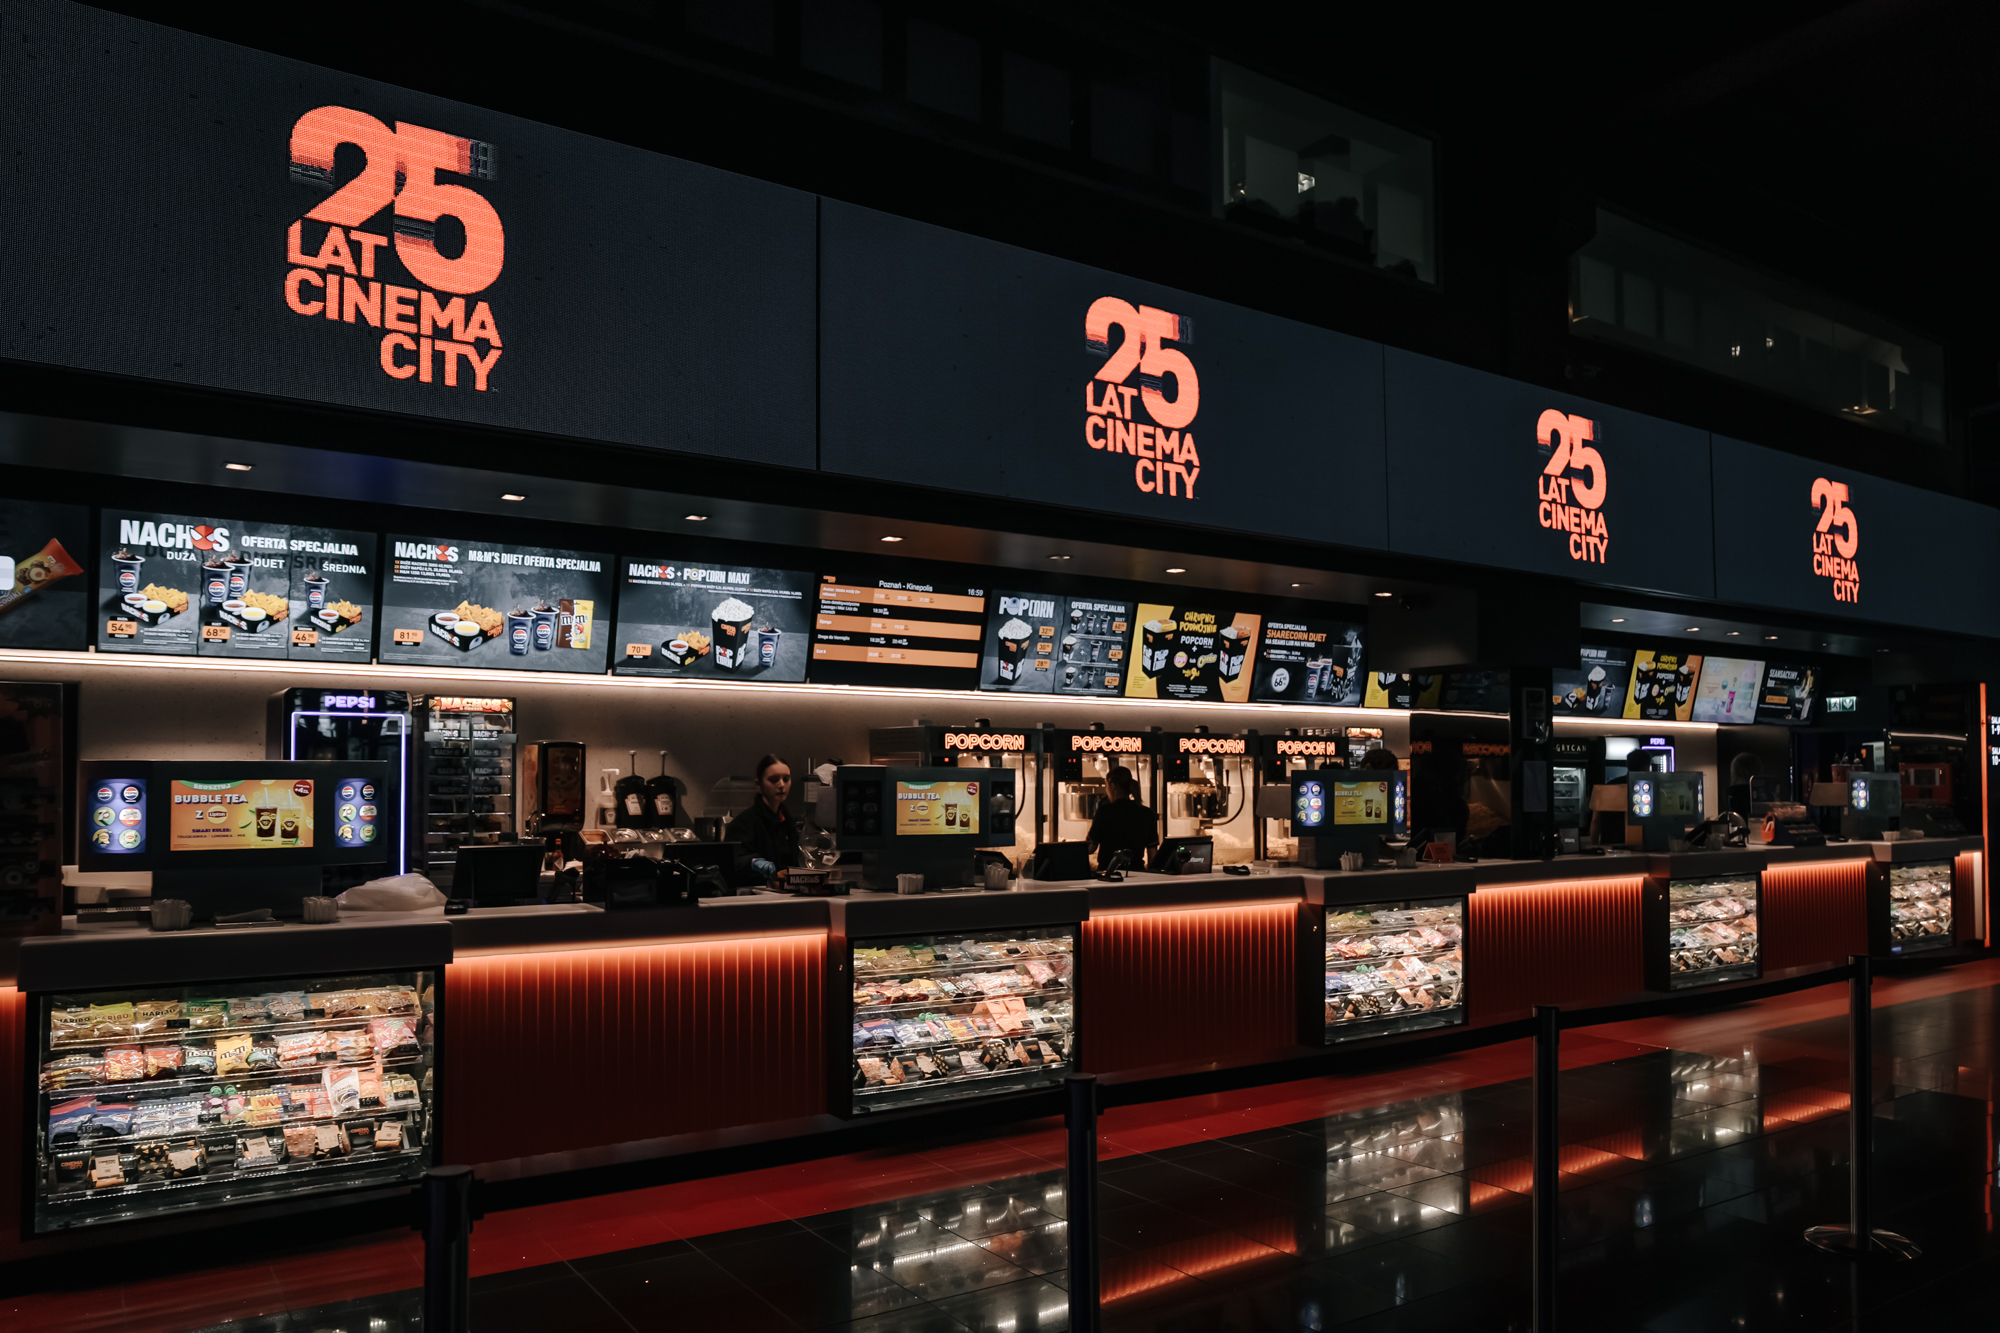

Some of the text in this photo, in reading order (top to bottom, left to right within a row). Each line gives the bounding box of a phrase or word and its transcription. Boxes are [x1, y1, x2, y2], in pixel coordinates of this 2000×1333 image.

[290, 106, 505, 295] 25
[287, 219, 389, 278] LAT
[284, 268, 503, 347] CINEMA
[381, 332, 503, 391] CITY
[1085, 296, 1199, 429] 25
[1086, 381, 1138, 420] LAT
[1085, 415, 1200, 466] CINEMA
[1537, 409, 1607, 510] 25
[1135, 459, 1200, 499] CITY
[1538, 475, 1570, 504] LAT
[1538, 501, 1608, 538] CINEMA
[1811, 477, 1858, 559] 25
[241, 535, 358, 555] OFERTA SPECJALNA
[1569, 533, 1608, 564] CITY
[1812, 532, 1834, 555] LAT
[167, 550, 197, 561] DUŻA
[501, 552, 524, 565] DUET
[524, 555, 554, 568] OFERTA
[556, 558, 601, 572] SPECJALNA
[253, 557, 285, 569] DUET
[322, 561, 367, 574] ŚREDNIA
[1813, 554, 1860, 582] CINEMA
[727, 571, 750, 585] MAXI
[879, 580, 901, 590] Poznań
[906, 583, 933, 593] Kinepolis
[967, 588, 984, 597] 16:59
[1833, 579, 1860, 603] CITY
[1071, 601, 1125, 613] OFERTA SPECJALNA
[111, 623, 124, 632] 54
[206, 629, 218, 637] 68
[1268, 622, 1307, 631] OFERTA SPECJALNA
[295, 633, 307, 641] 46
[1180, 635, 1214, 646] POPCORN
[1266, 629, 1327, 642] SHARECORN DUET
[1274, 677, 1283, 687] 66
[324, 695, 376, 708] PEPSI
[441, 697, 502, 711] NACHOS
[945, 733, 1025, 750] POPCORN
[1071, 735, 1142, 753] POPCORN
[1179, 738, 1245, 754] POPCORN
[1277, 740, 1335, 755] POPCORN
[1555, 743, 1587, 752] GRYCAN
[174, 793, 248, 805] BUBBLE TEA
[927, 792, 941, 801] TEA
[195, 810, 204, 820] Z
[56, 1016, 91, 1024] HARIBO
[94, 1013, 129, 1021] HARIBO
